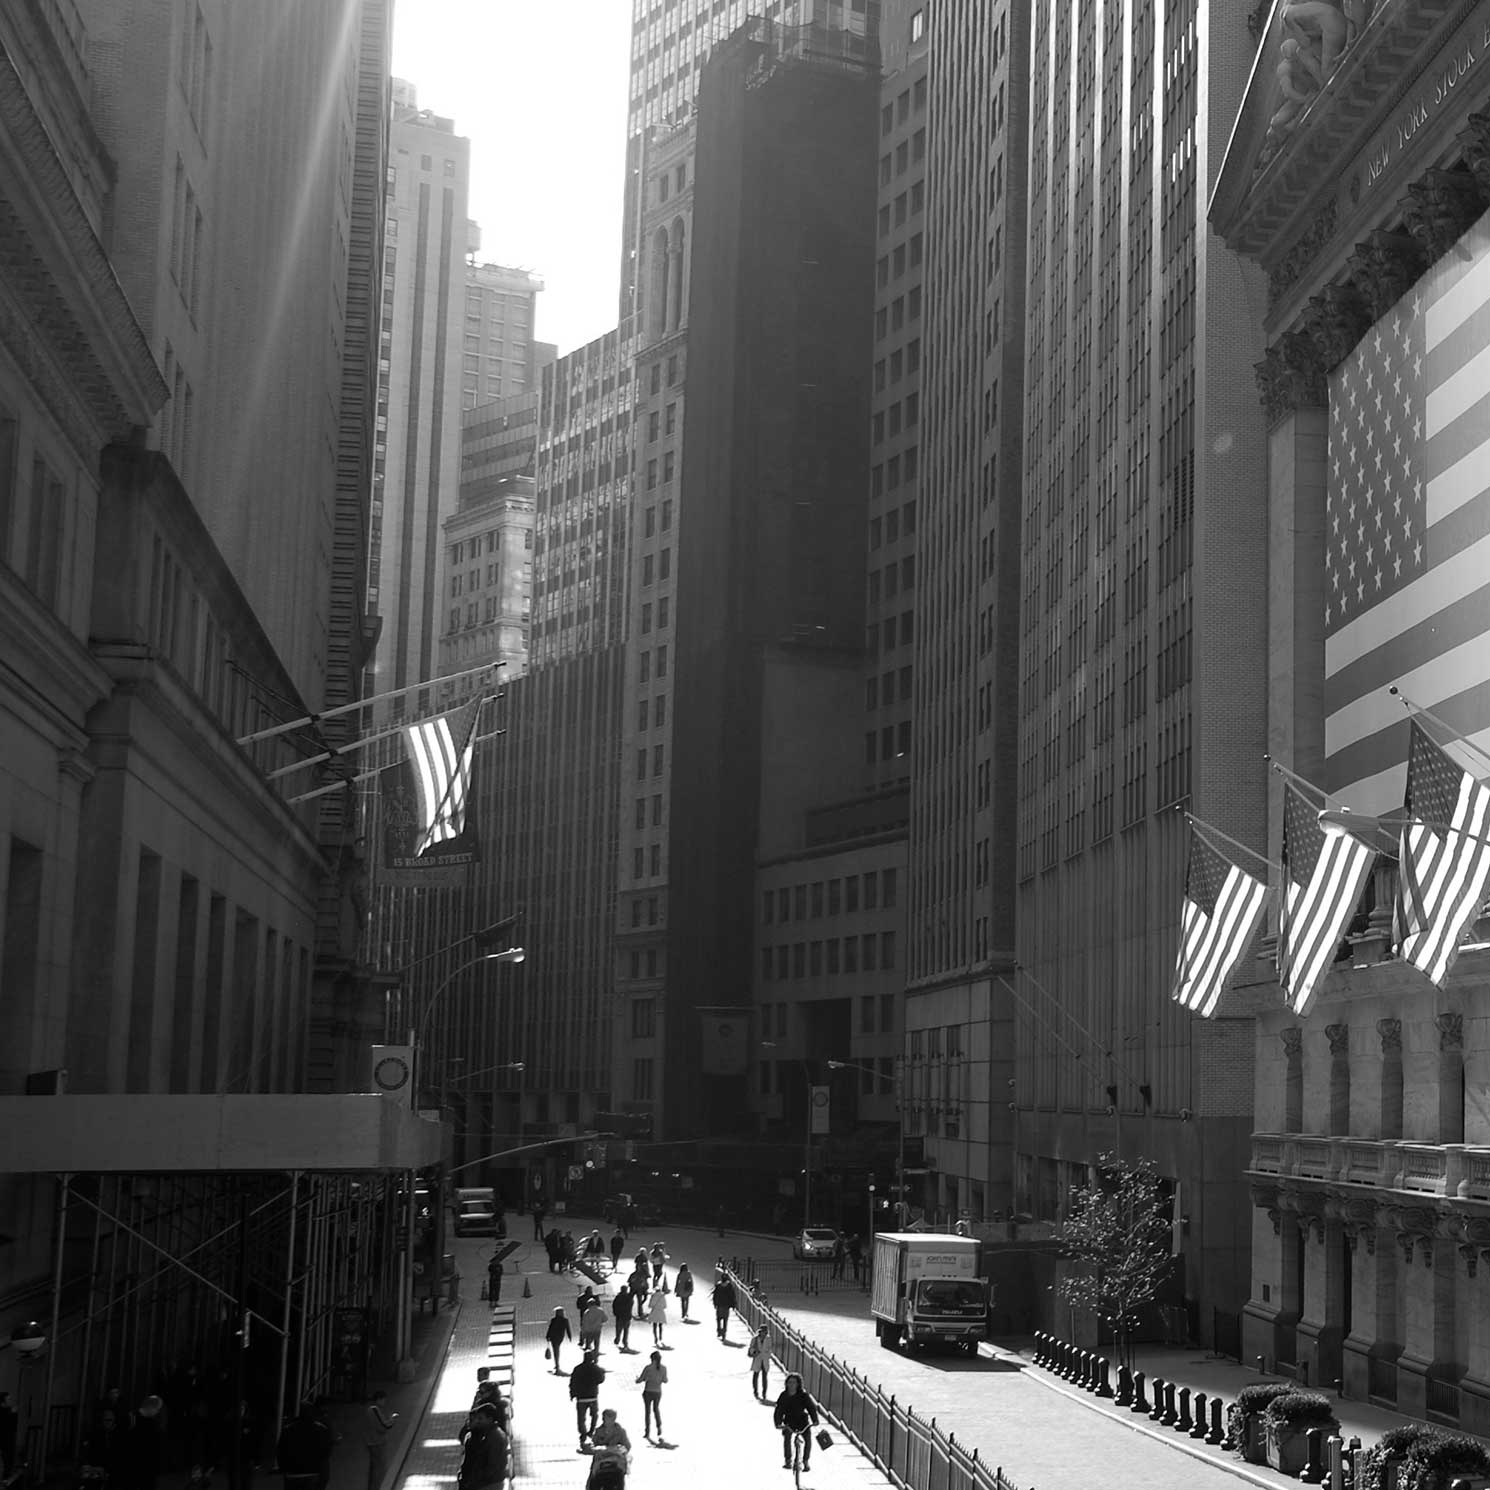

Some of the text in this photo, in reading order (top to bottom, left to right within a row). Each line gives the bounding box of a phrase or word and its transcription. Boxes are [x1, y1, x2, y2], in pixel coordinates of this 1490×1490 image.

[1367, 142, 1390, 187] NEW
[1396, 98, 1428, 149] YORK
[1435, 43, 1476, 104] STOCK
[438, 853, 472, 865] STREET
